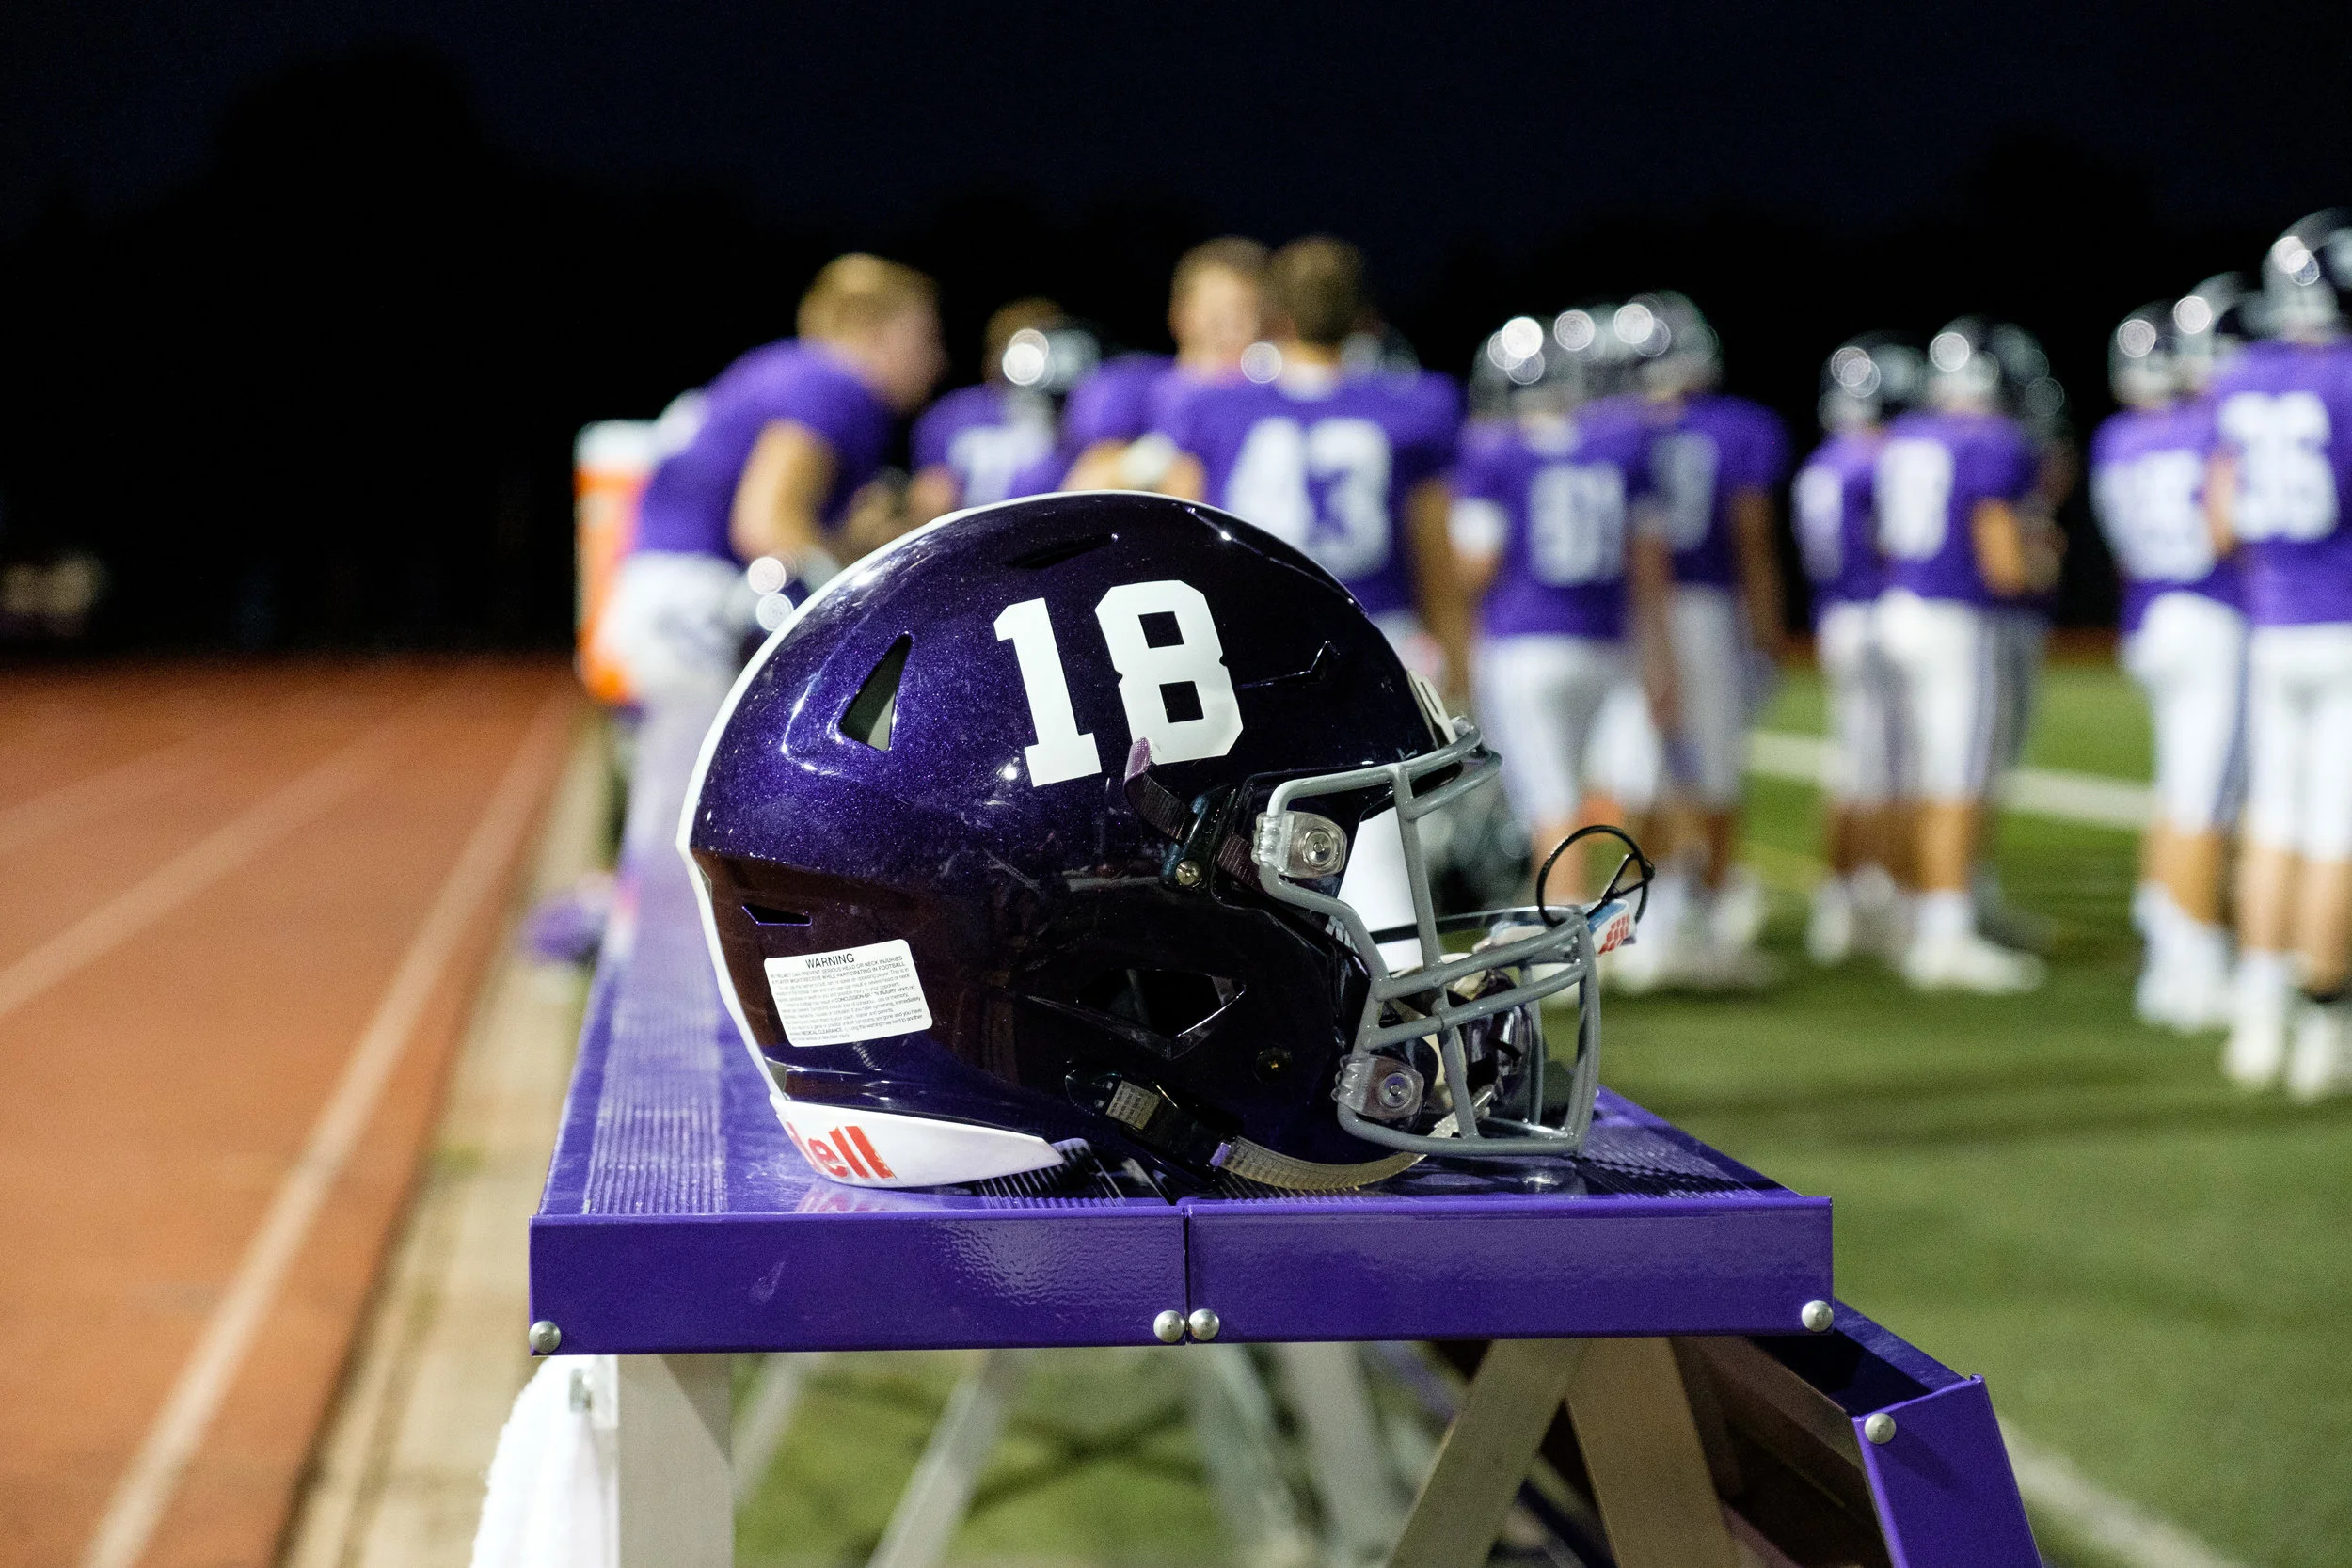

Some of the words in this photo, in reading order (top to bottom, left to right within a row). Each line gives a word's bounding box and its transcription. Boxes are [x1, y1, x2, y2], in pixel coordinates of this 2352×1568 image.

[1224, 416, 1394, 580] 43
[993, 579, 1243, 787] 18
[805, 953, 854, 969] WARNING
